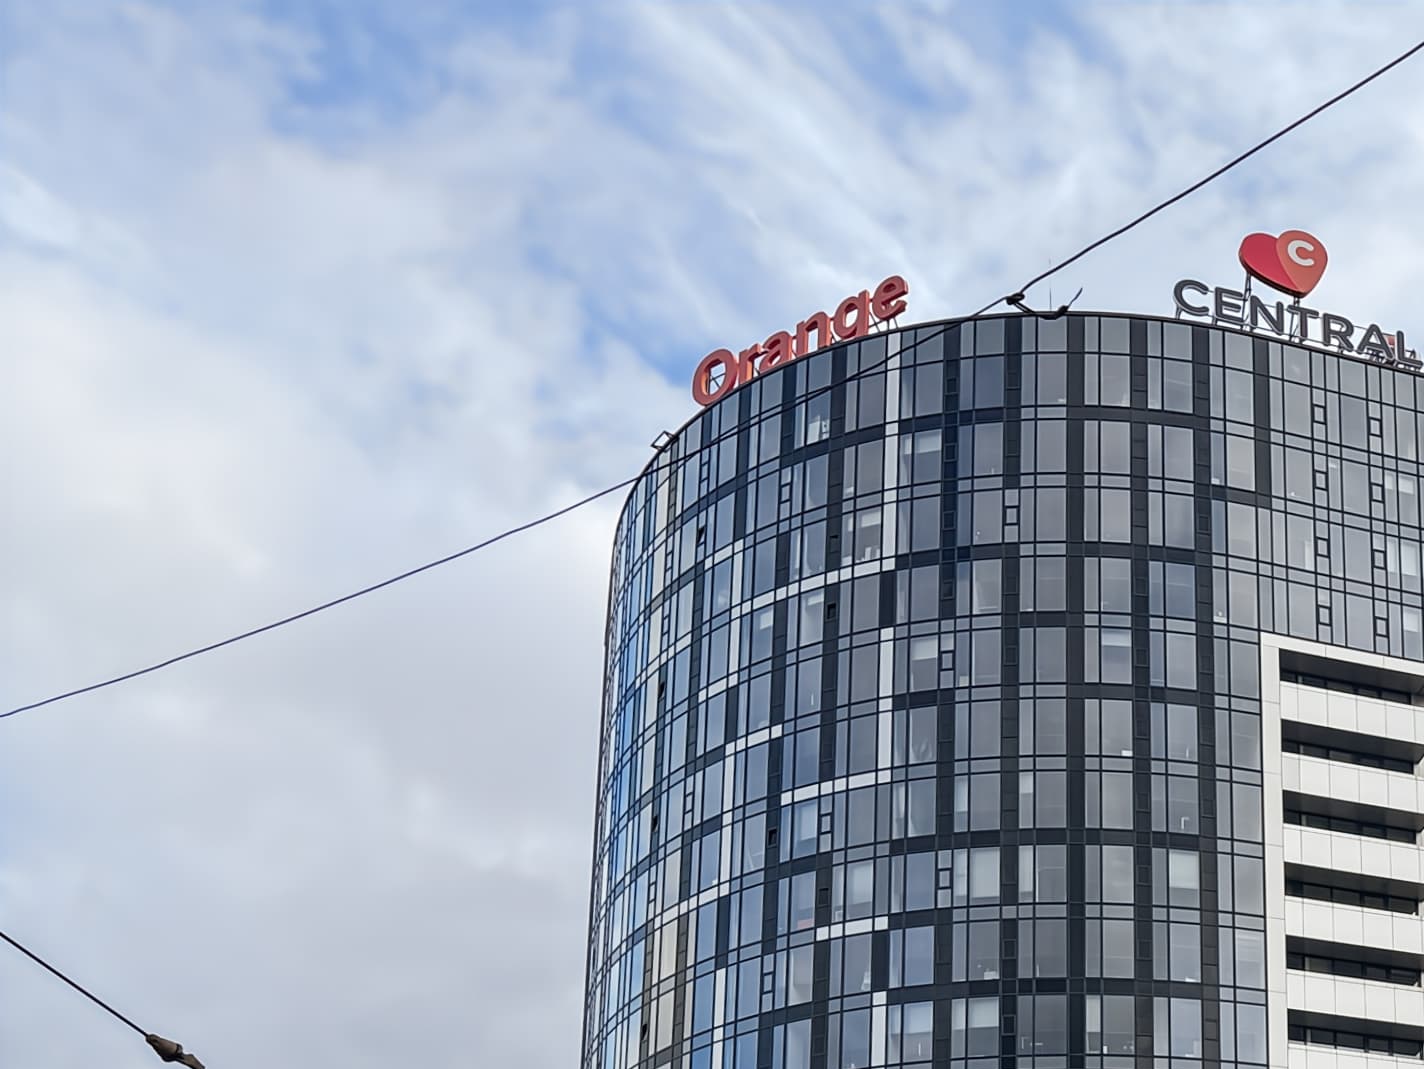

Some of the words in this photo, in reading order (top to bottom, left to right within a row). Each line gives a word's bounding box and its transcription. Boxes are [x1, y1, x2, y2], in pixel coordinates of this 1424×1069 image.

[1287, 239, 1315, 266] C
[692, 275, 908, 406] Orange
[1173, 279, 1424, 369] CENTRAL
